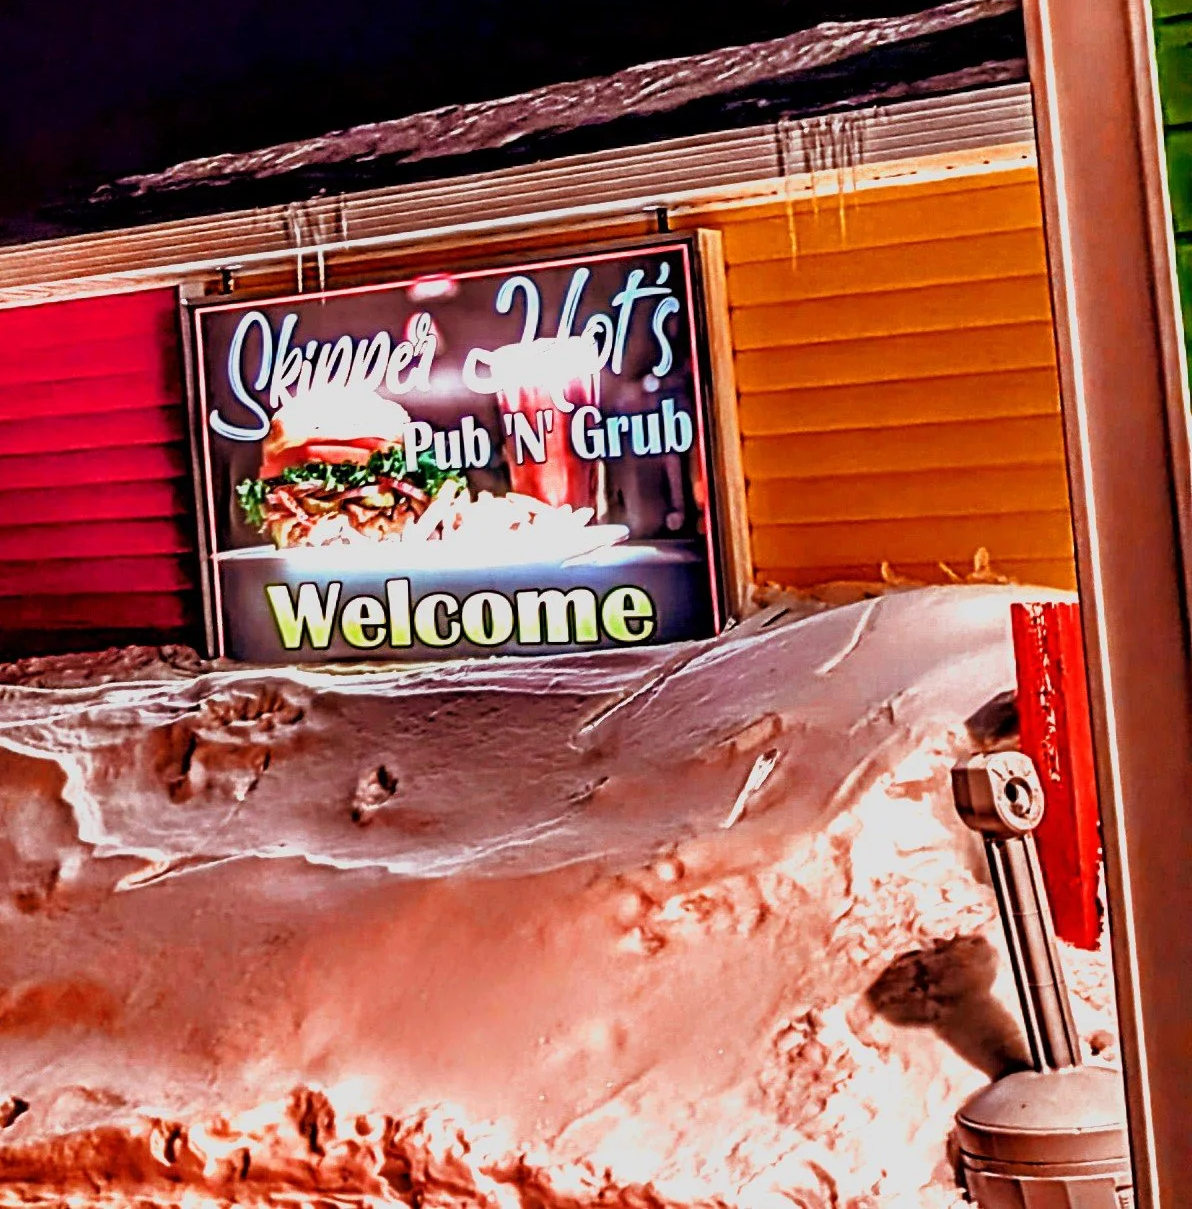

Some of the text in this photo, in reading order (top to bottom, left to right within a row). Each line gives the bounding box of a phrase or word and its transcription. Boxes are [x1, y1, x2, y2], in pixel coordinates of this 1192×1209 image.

[209, 311, 437, 441] Skipper
[403, 413, 492, 473] Pub
[571, 399, 694, 459] Grub
[265, 578, 655, 650] Welcome
